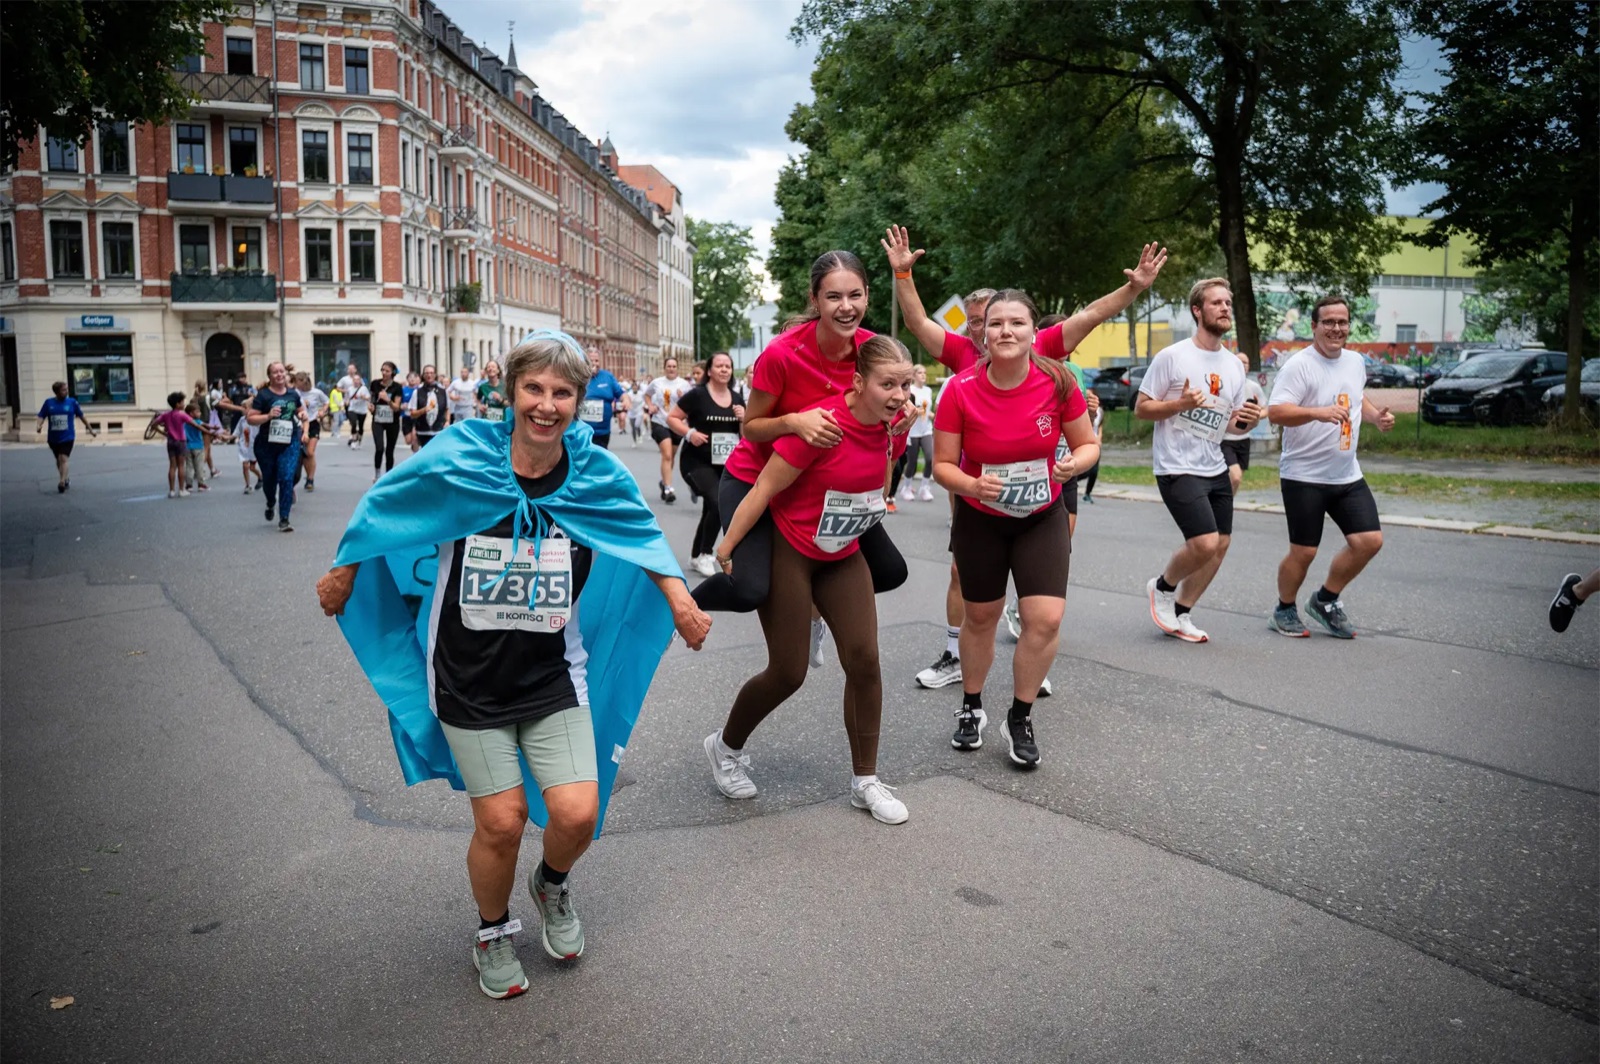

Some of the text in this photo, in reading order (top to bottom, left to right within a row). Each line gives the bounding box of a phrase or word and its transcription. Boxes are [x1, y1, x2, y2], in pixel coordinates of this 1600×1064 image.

[714, 444, 735, 455] 162
[1000, 482, 1048, 504] 7748
[821, 512, 884, 535] 17747
[470, 547, 500, 561] FIRMENLAUF
[466, 572, 567, 604] 17365
[505, 613, 544, 622] komsa
